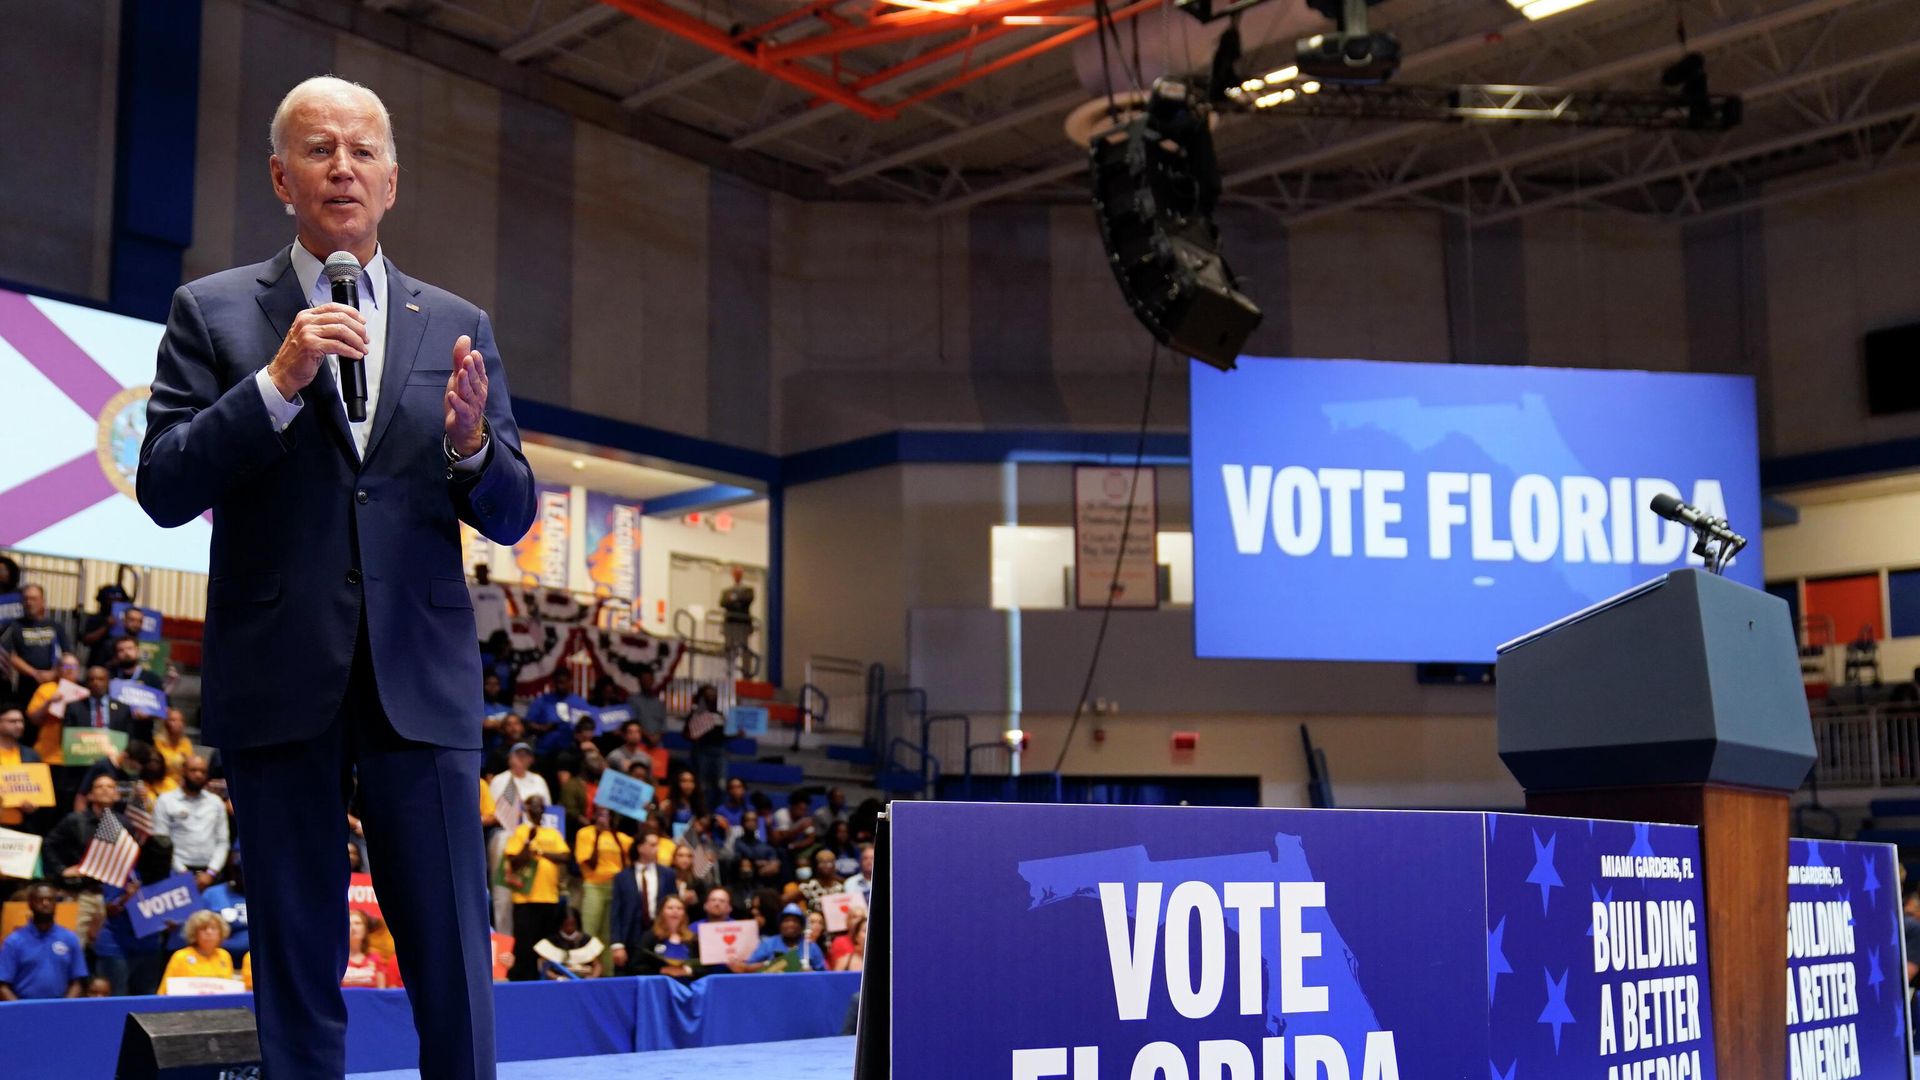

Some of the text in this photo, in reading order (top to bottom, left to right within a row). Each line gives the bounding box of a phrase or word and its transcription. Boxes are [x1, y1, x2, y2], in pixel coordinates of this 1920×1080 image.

[1222, 464, 1737, 566] VOTE FLORIDA
[137, 885, 192, 918] VOTE!
[1601, 855, 1695, 882] MIAMI GARDENS, FL
[1832, 866, 1844, 885] FL
[1099, 880, 1330, 1020] VOTE
[1592, 899, 1698, 973] BUILDING
[1600, 974, 1701, 1056] A BETTER
[1786, 961, 1859, 1027] A BETTER
[1790, 1022, 1861, 1080] AMERICA
